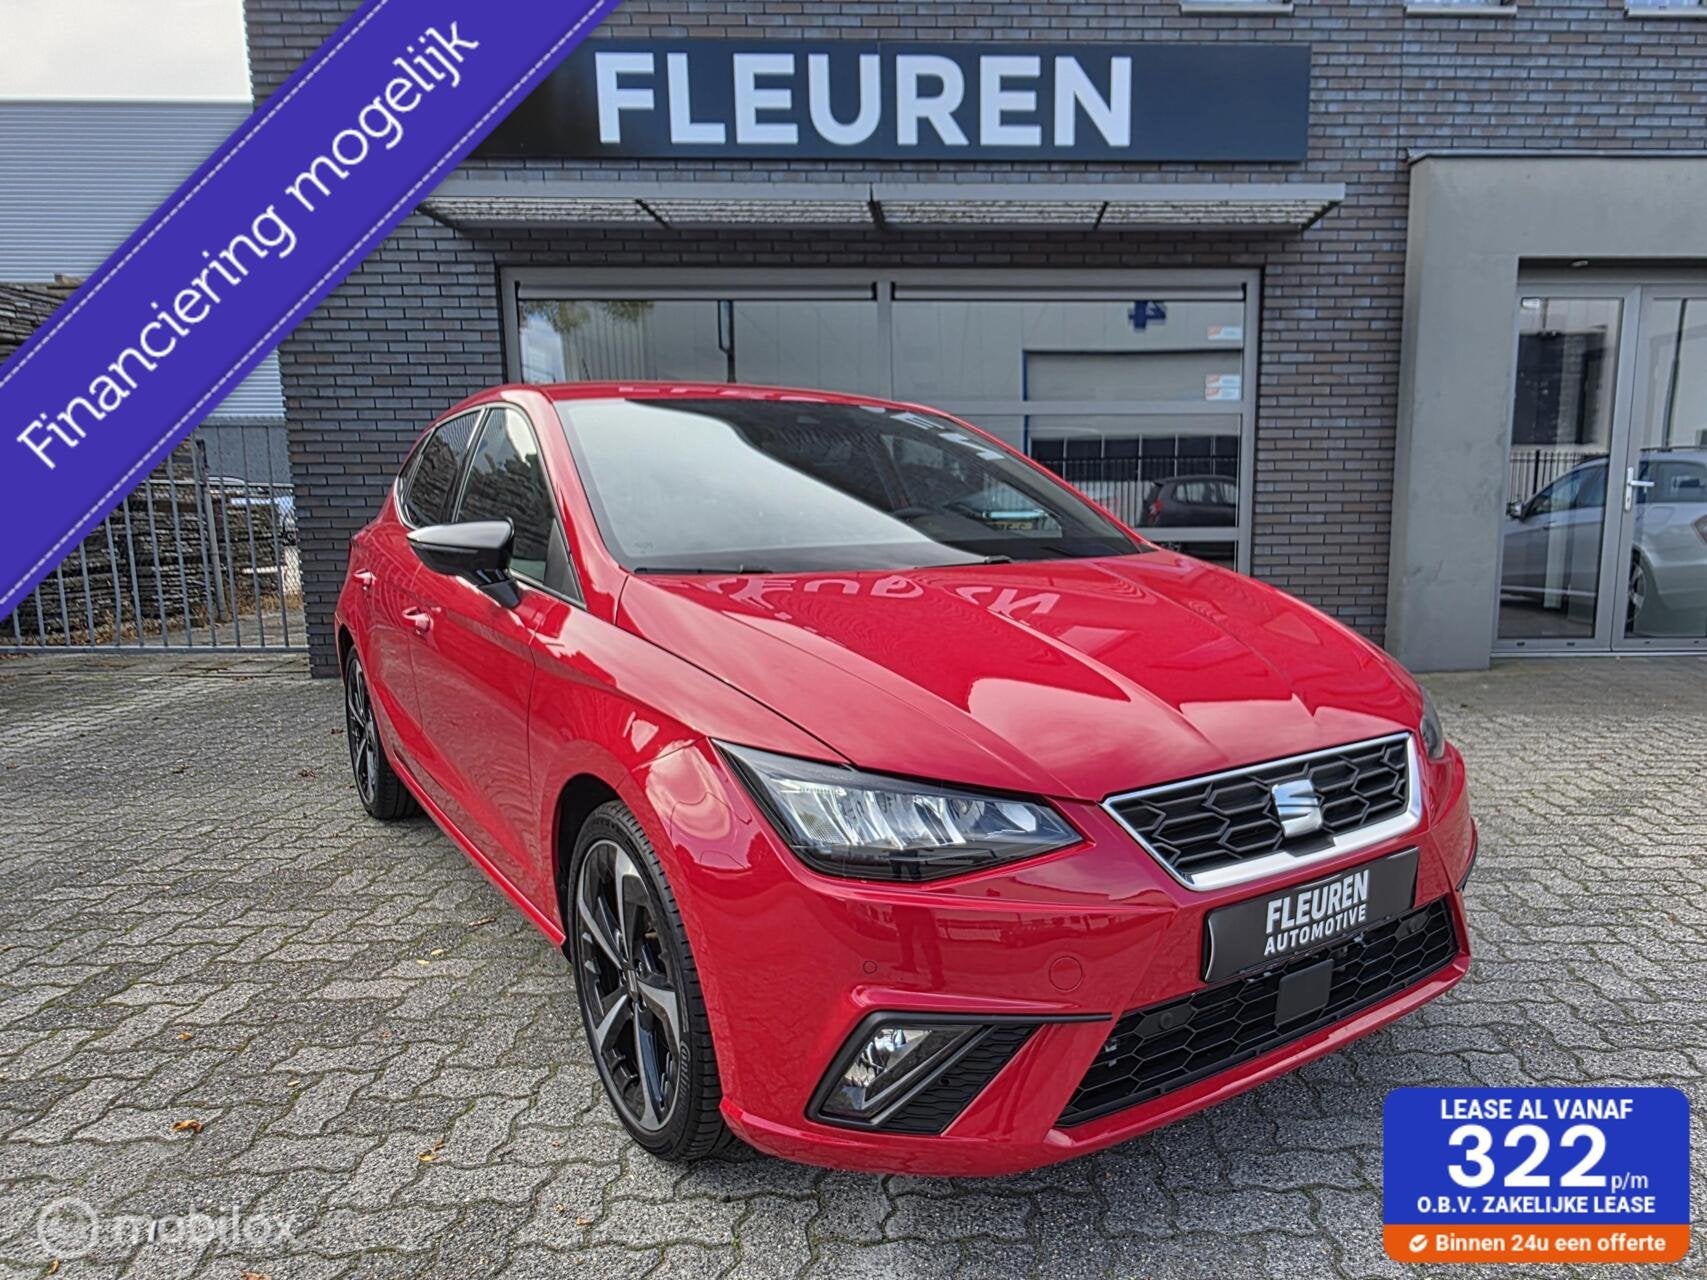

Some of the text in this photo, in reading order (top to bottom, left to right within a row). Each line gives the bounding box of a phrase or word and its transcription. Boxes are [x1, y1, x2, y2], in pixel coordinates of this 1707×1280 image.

[595, 51, 1132, 147] FLEUREN
[1264, 903, 1367, 956] AUTOMOTIVE
[1265, 869, 1370, 934] FLEUREN
